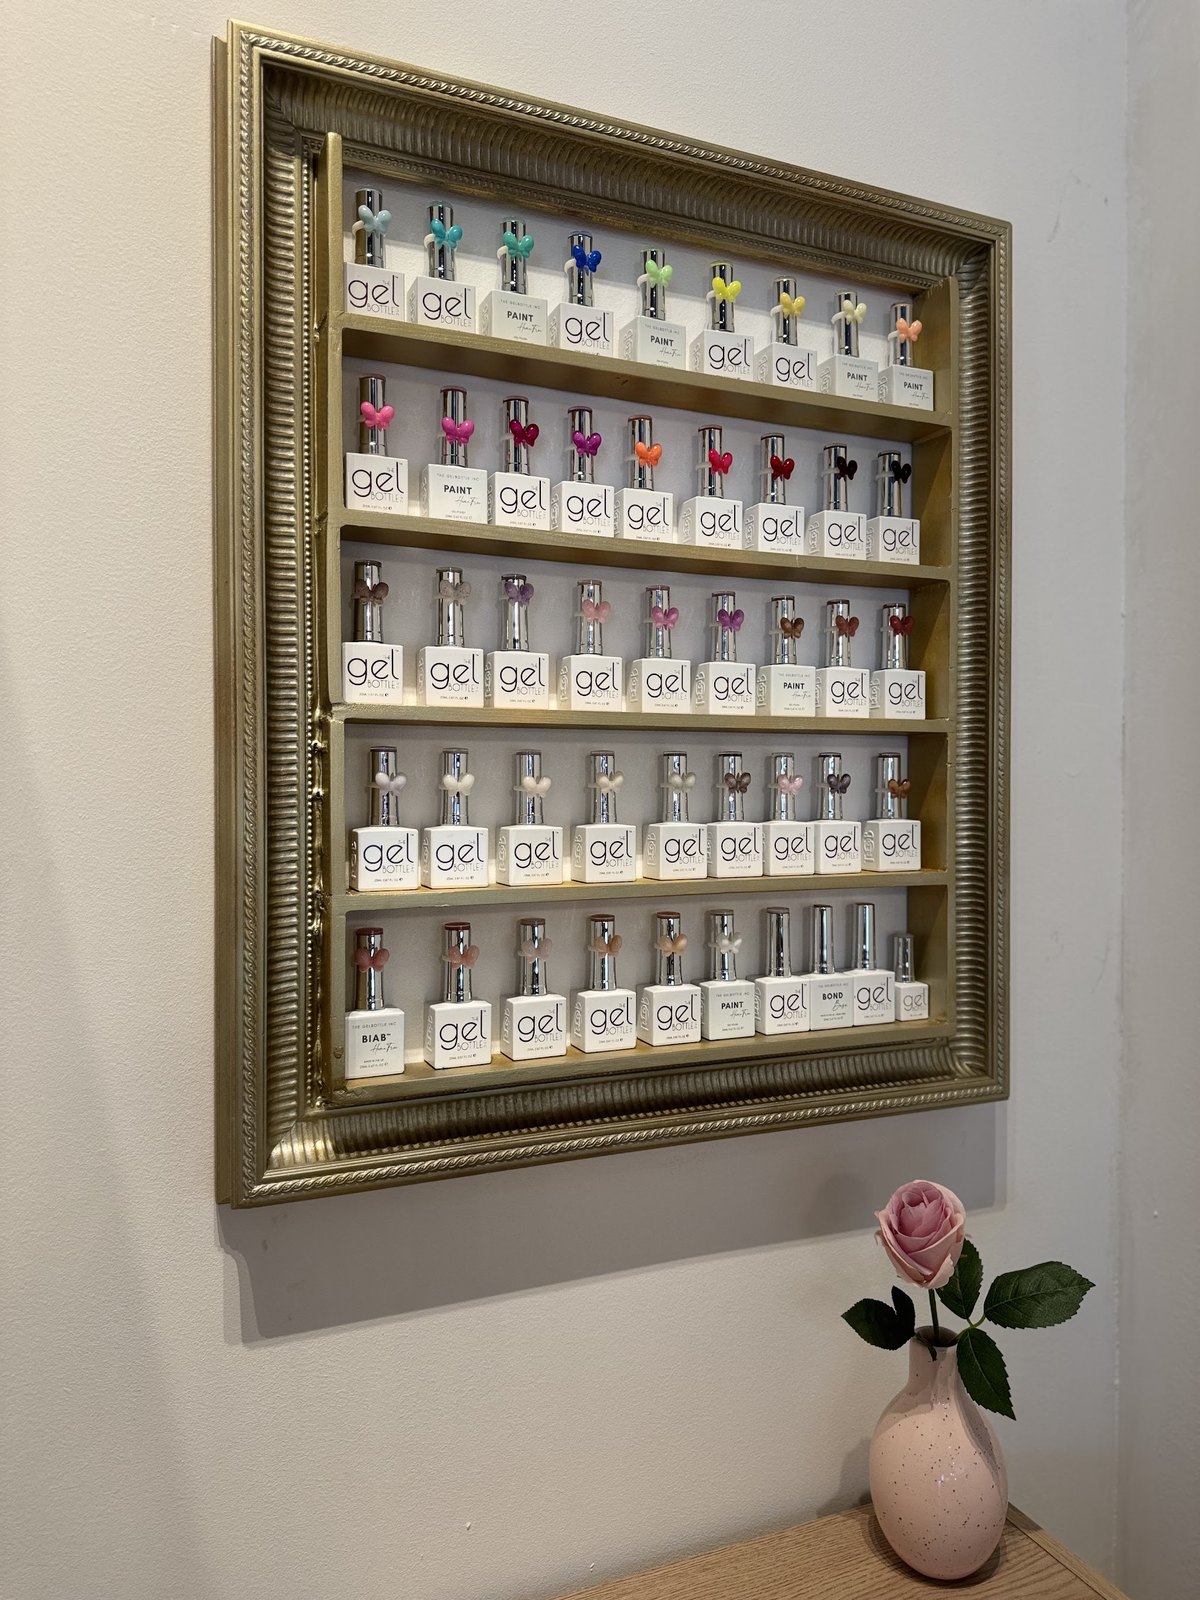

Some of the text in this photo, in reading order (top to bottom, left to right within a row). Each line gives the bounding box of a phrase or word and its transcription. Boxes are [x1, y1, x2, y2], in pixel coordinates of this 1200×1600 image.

[348, 275, 399, 308] gel
[423, 288, 471, 320] gel
[507, 310, 533, 322] PAINT
[565, 312, 609, 343] gel
[650, 335, 674, 347] PAINT
[709, 339, 750, 369] gel
[776, 353, 813, 382] gel
[847, 372, 867, 381] PAINT
[904, 382, 923, 390] PAINT
[352, 462, 404, 497] gel
[444, 485, 472, 494] PAINT
[500, 480, 546, 514] gel
[567, 489, 610, 522] gel
[628, 498, 669, 529] gel
[701, 505, 739, 536] gel
[763, 511, 801, 542] gel
[828, 516, 863, 546] gel
[883, 522, 917, 551] gel
[347, 649, 399, 685] gel
[430, 654, 479, 689] gel
[500, 657, 545, 692] gel
[576, 662, 618, 696] gel
[647, 665, 687, 698] gel
[714, 668, 752, 700] gel
[784, 682, 804, 690] PAINT
[831, 673, 866, 704] gel
[889, 675, 922, 705] gel
[363, 833, 413, 872] gel
[436, 833, 484, 871] gel
[514, 831, 559, 868] gel
[590, 831, 632, 866] gel
[665, 829, 704, 863] gel
[721, 827, 759, 861] gel
[774, 827, 811, 860] gel
[825, 826, 858, 858] gel
[882, 825, 917, 856] gel
[770, 984, 807, 1019] gel
[822, 992, 843, 1000] BOND
[857, 977, 891, 1010] gel
[518, 1002, 562, 1042] gel
[591, 997, 632, 1035] gel
[657, 994, 696, 1030] gel
[440, 1010, 487, 1050] gel
